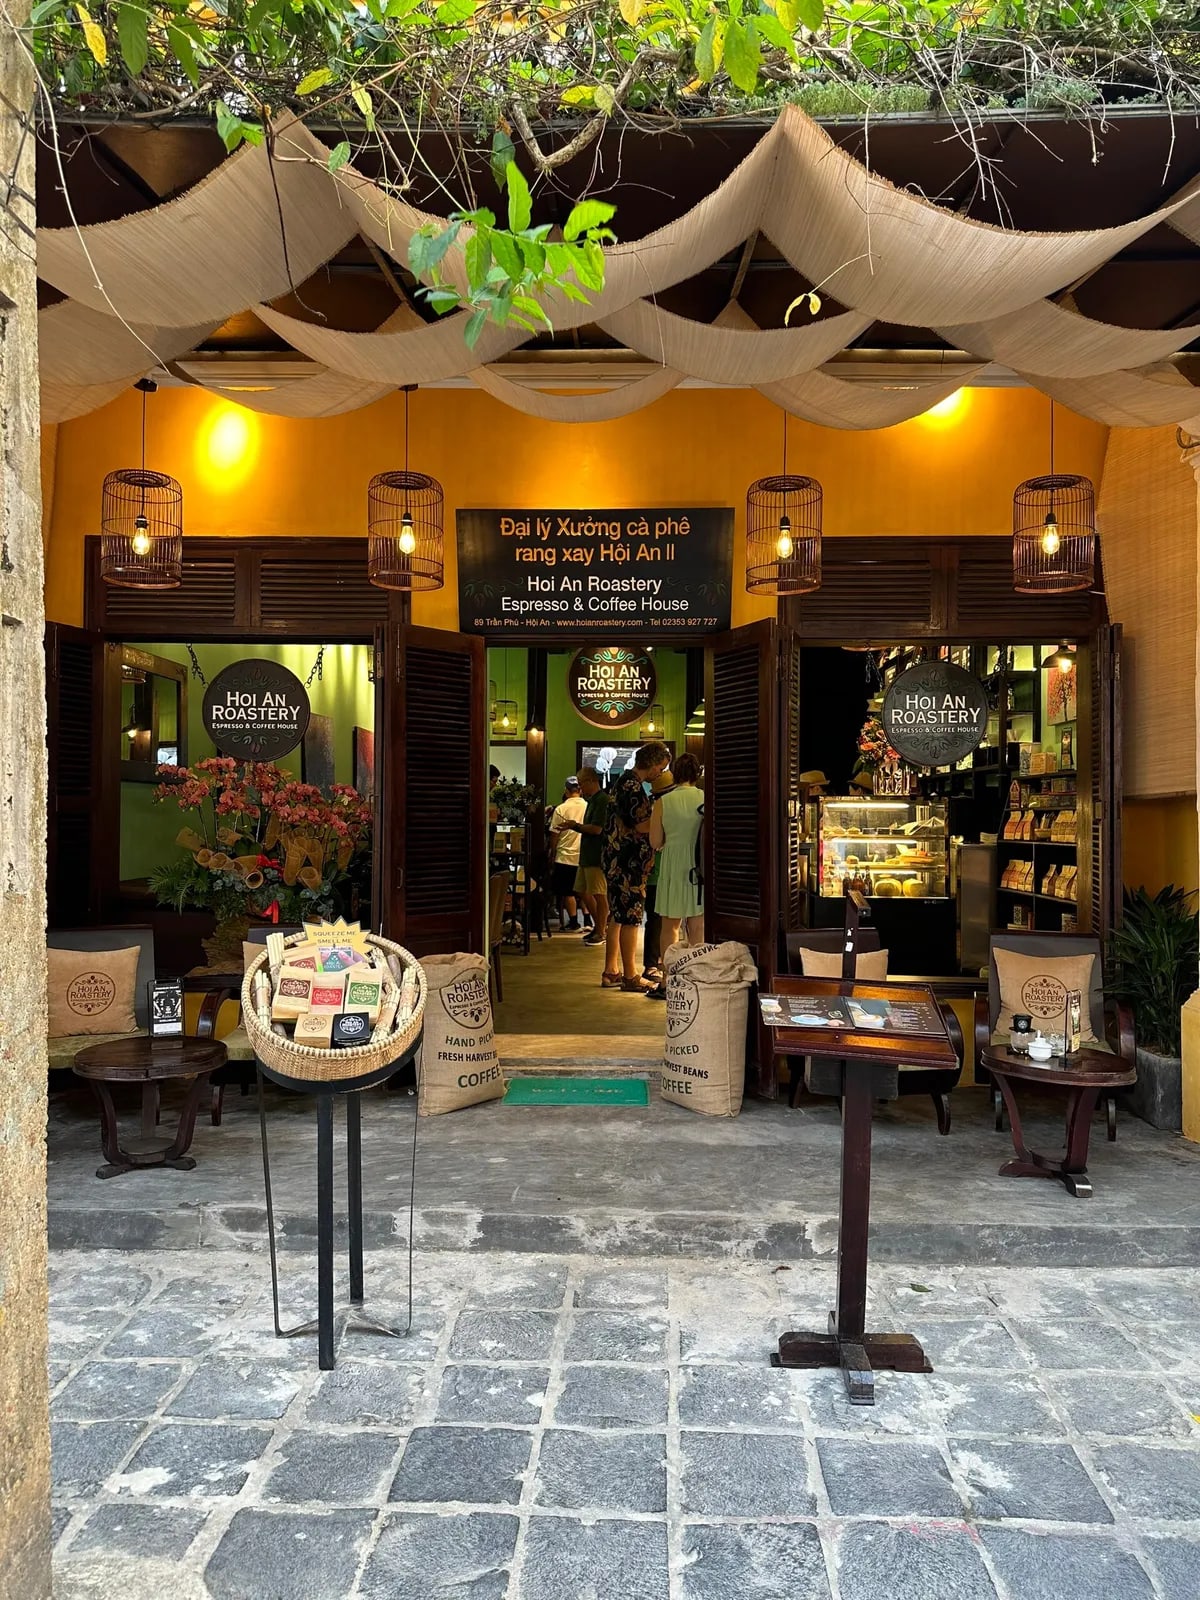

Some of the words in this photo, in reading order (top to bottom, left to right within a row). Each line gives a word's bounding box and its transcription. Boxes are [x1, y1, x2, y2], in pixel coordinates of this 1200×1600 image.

[500, 517, 531, 540] Đại
[536, 517, 552, 541] lý
[556, 515, 621, 541] Xưởng
[626, 516, 650, 536] cà
[655, 516, 691, 540] phê
[515, 547, 557, 566] rang
[562, 547, 595, 566] xay
[600, 543, 631, 565] Hội
[635, 543, 661, 561] An
[527, 575, 555, 592] Hoi
[560, 575, 583, 592] An
[588, 576, 662, 595] Roastery
[501, 597, 569, 615] Espresso
[573, 597, 584, 611] &
[588, 596, 637, 611] Coffee
[641, 596, 689, 611] House
[474, 618, 484, 626] 89
[540, 618, 550, 626] An
[556, 618, 643, 628] www.hoianroastery.com
[650, 618, 661, 626] Tel
[662, 618, 686, 626] 02353
[687, 618, 701, 626] 927
[703, 618, 718, 626] 727
[589, 664, 615, 678] HOI
[619, 664, 639, 678] AN
[577, 677, 651, 690] ROASTERY
[226, 691, 257, 706] HOI
[262, 691, 286, 706] AN
[906, 694, 936, 710] HOI
[942, 693, 966, 709] AN
[212, 704, 300, 720] ROASTERY
[891, 707, 981, 724] ROASTERY
[445, 1035, 475, 1047] HAND
[438, 1051, 464, 1061] FRESH
[465, 1051, 492, 1061] HARVEST
[670, 1044, 699, 1055] PICKED
[457, 1064, 501, 1088] COFFEE
[683, 1066, 709, 1079] BEANS
[662, 1077, 692, 1095] OFFEE
